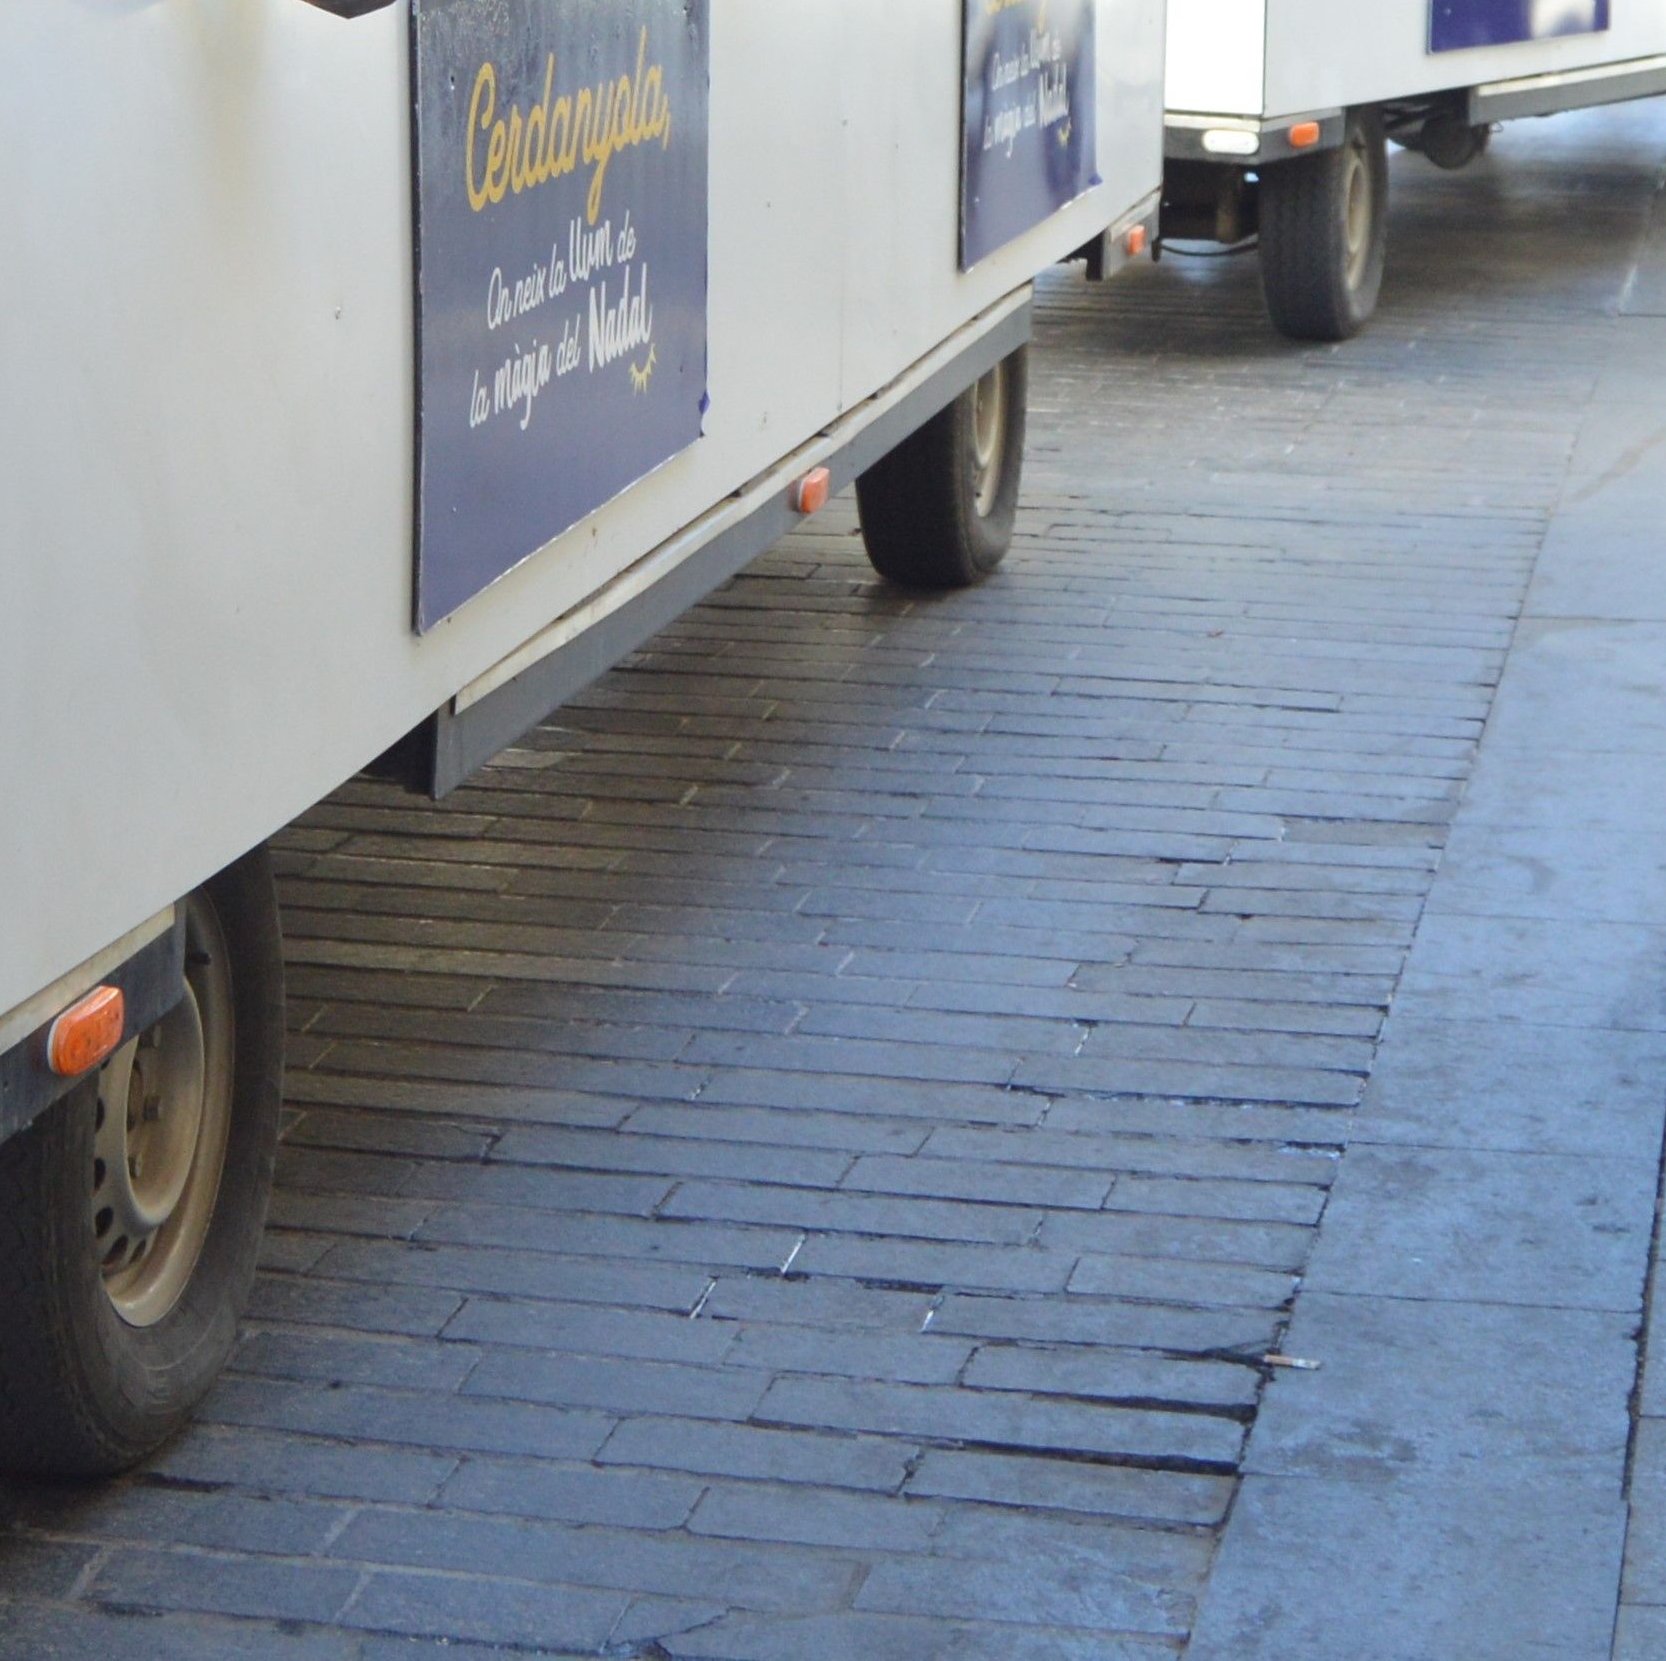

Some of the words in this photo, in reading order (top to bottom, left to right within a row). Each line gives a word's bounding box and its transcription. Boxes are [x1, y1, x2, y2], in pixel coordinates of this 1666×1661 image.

[487, 267, 513, 330] On
[512, 262, 546, 318] neix
[548, 243, 568, 299] la
[617, 209, 637, 264] de
[469, 369, 491, 429] la
[494, 338, 553, 432] màgia
[556, 312, 582, 377] del
[588, 261, 653, 374] Nadal
